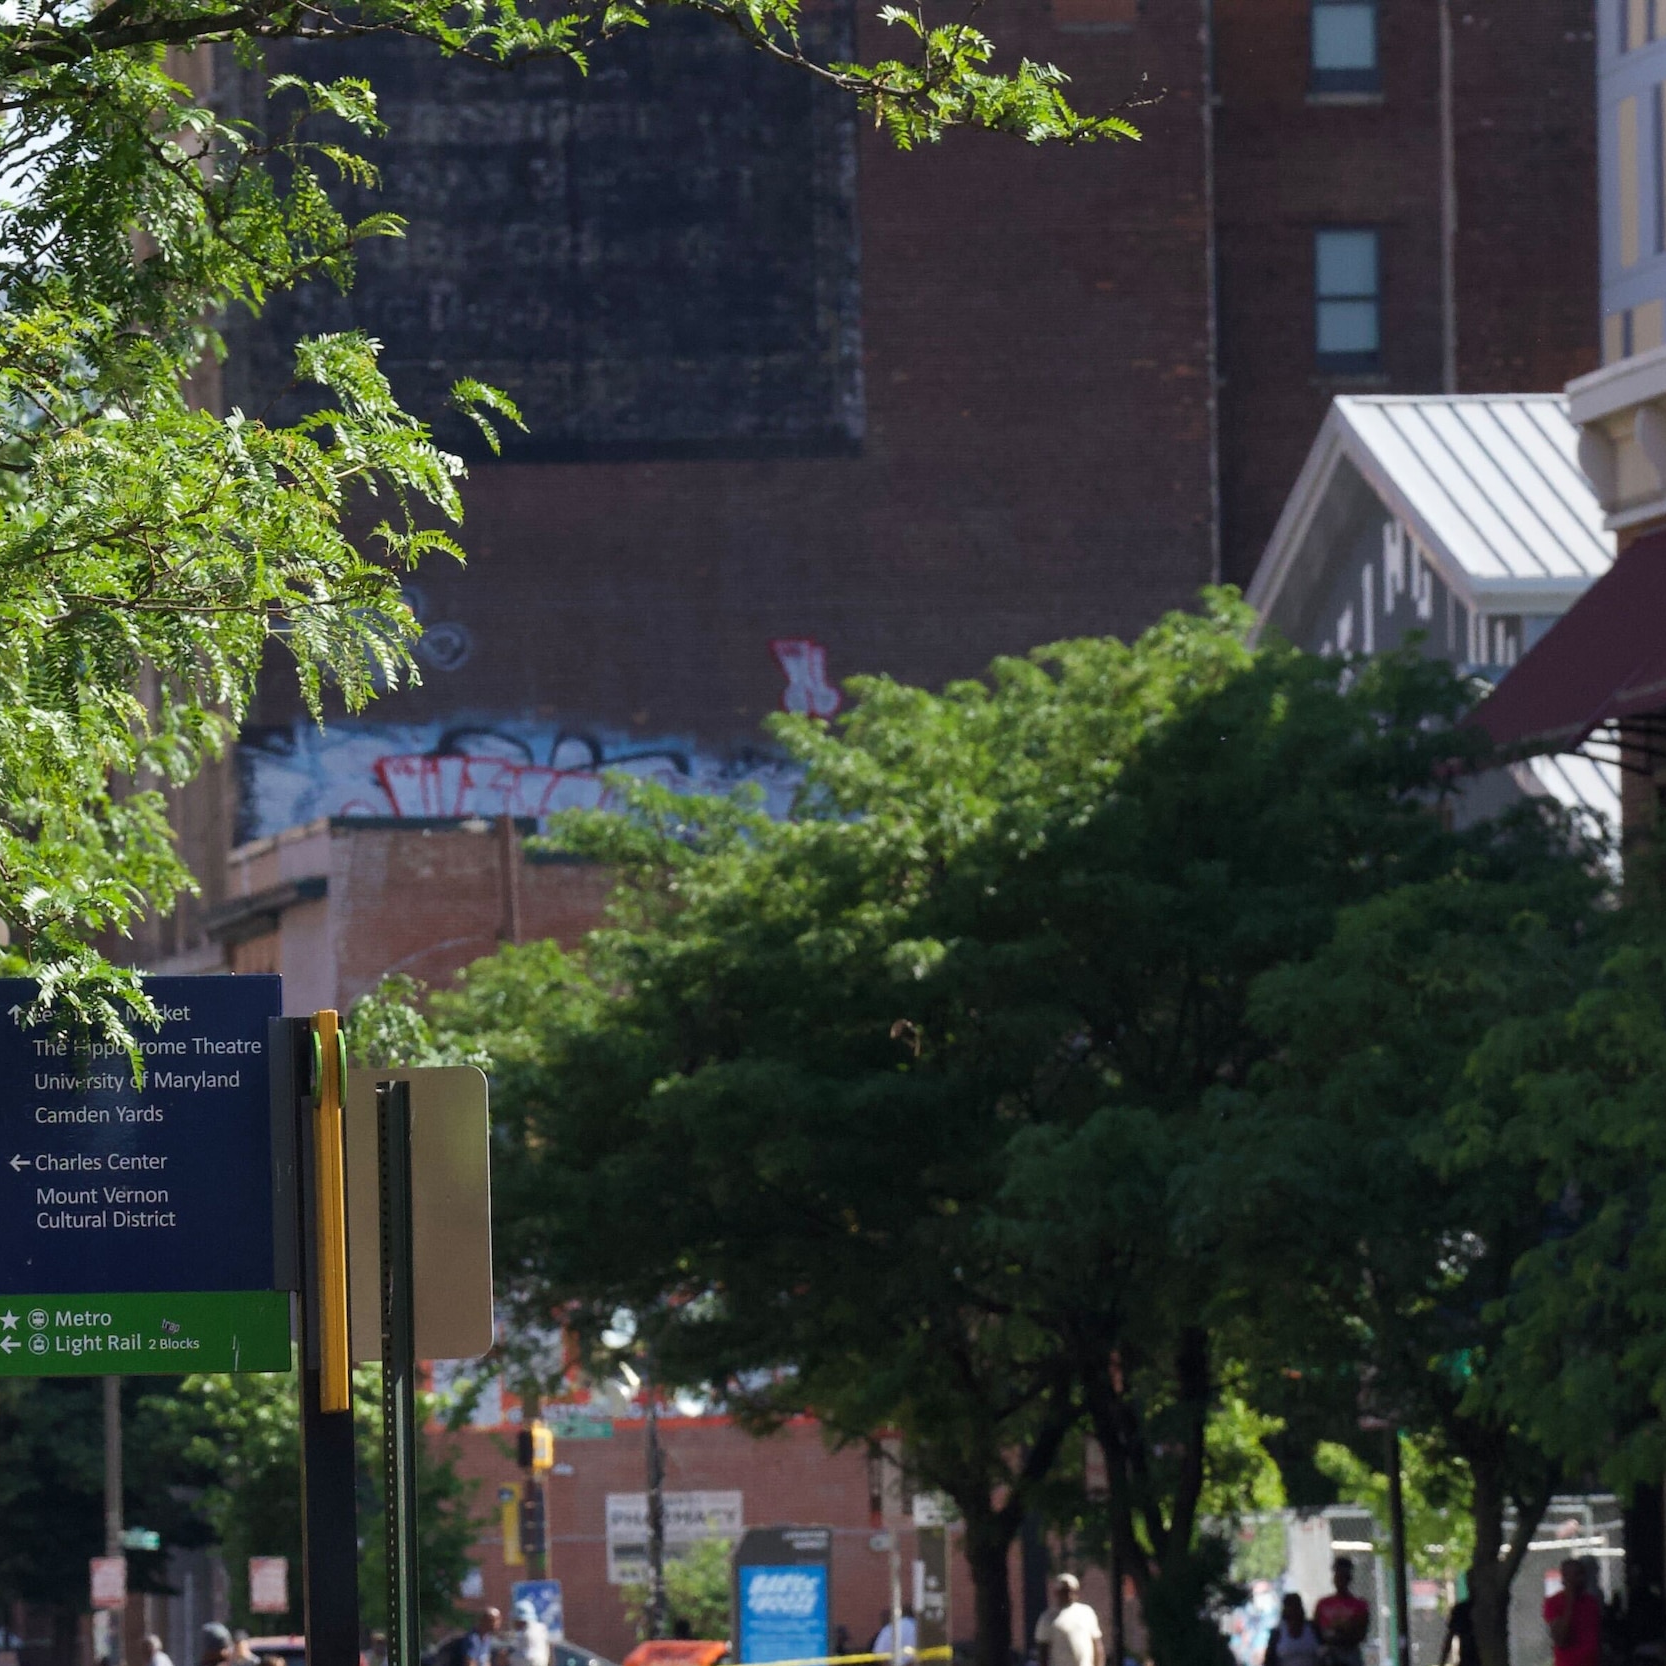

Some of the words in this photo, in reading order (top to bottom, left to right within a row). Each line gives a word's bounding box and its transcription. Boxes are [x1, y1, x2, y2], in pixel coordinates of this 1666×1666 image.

[33, 1039, 67, 1056] The
[192, 1037, 262, 1055] Theatre
[34, 1072, 124, 1093] University
[130, 1071, 148, 1089] of
[154, 1070, 240, 1092] Maryland
[35, 1106, 110, 1124] Camden
[116, 1105, 164, 1123] Yards
[35, 1153, 102, 1171] Charles
[108, 1153, 168, 1170] Center
[36, 1187, 98, 1205] Mount
[103, 1186, 169, 1204] Vernon
[37, 1210, 107, 1229] Cultural
[113, 1210, 176, 1228] District
[55, 1310, 112, 1327] Metro
[55, 1334, 103, 1356] Light
[108, 1334, 141, 1351] Rail
[148, 1338, 157, 1350] 2
[160, 1337, 200, 1350] Blocks
[611, 1510, 736, 1528] PHMACY
